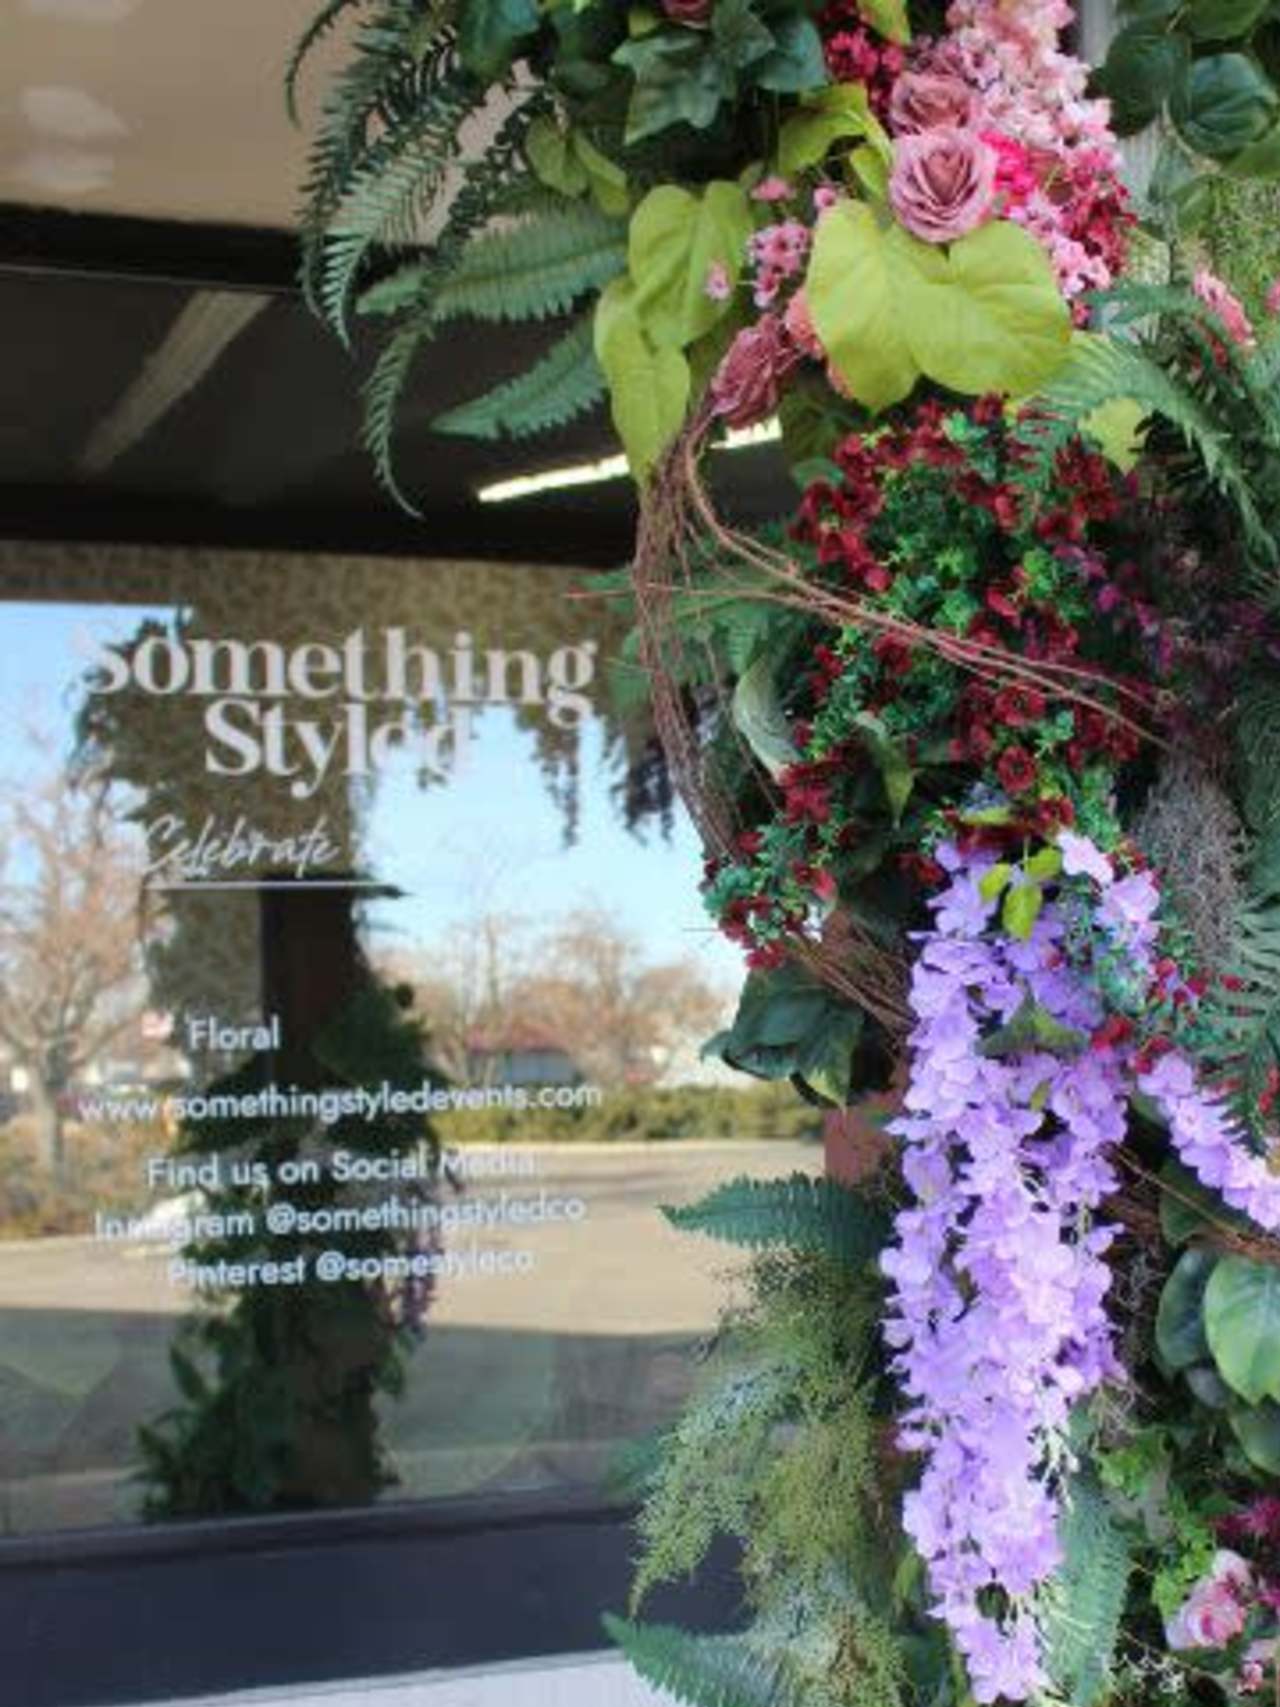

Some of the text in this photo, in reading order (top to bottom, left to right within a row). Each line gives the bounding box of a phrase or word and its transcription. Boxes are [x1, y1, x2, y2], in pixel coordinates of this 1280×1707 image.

[203, 697, 473, 798] Styled
[143, 811, 341, 879] Celebrate
[189, 1013, 280, 1051] Floral
[77, 1080, 601, 1124] wwwsomethingstyledevents.com
[147, 1152, 218, 1187] Find
[231, 1160, 268, 1185] us
[278, 1158, 320, 1184] on
[332, 1141, 427, 1180] Social
[94, 1189, 586, 1249] Ingram @somethingstyledco
[168, 1255, 304, 1288] Pinterest
